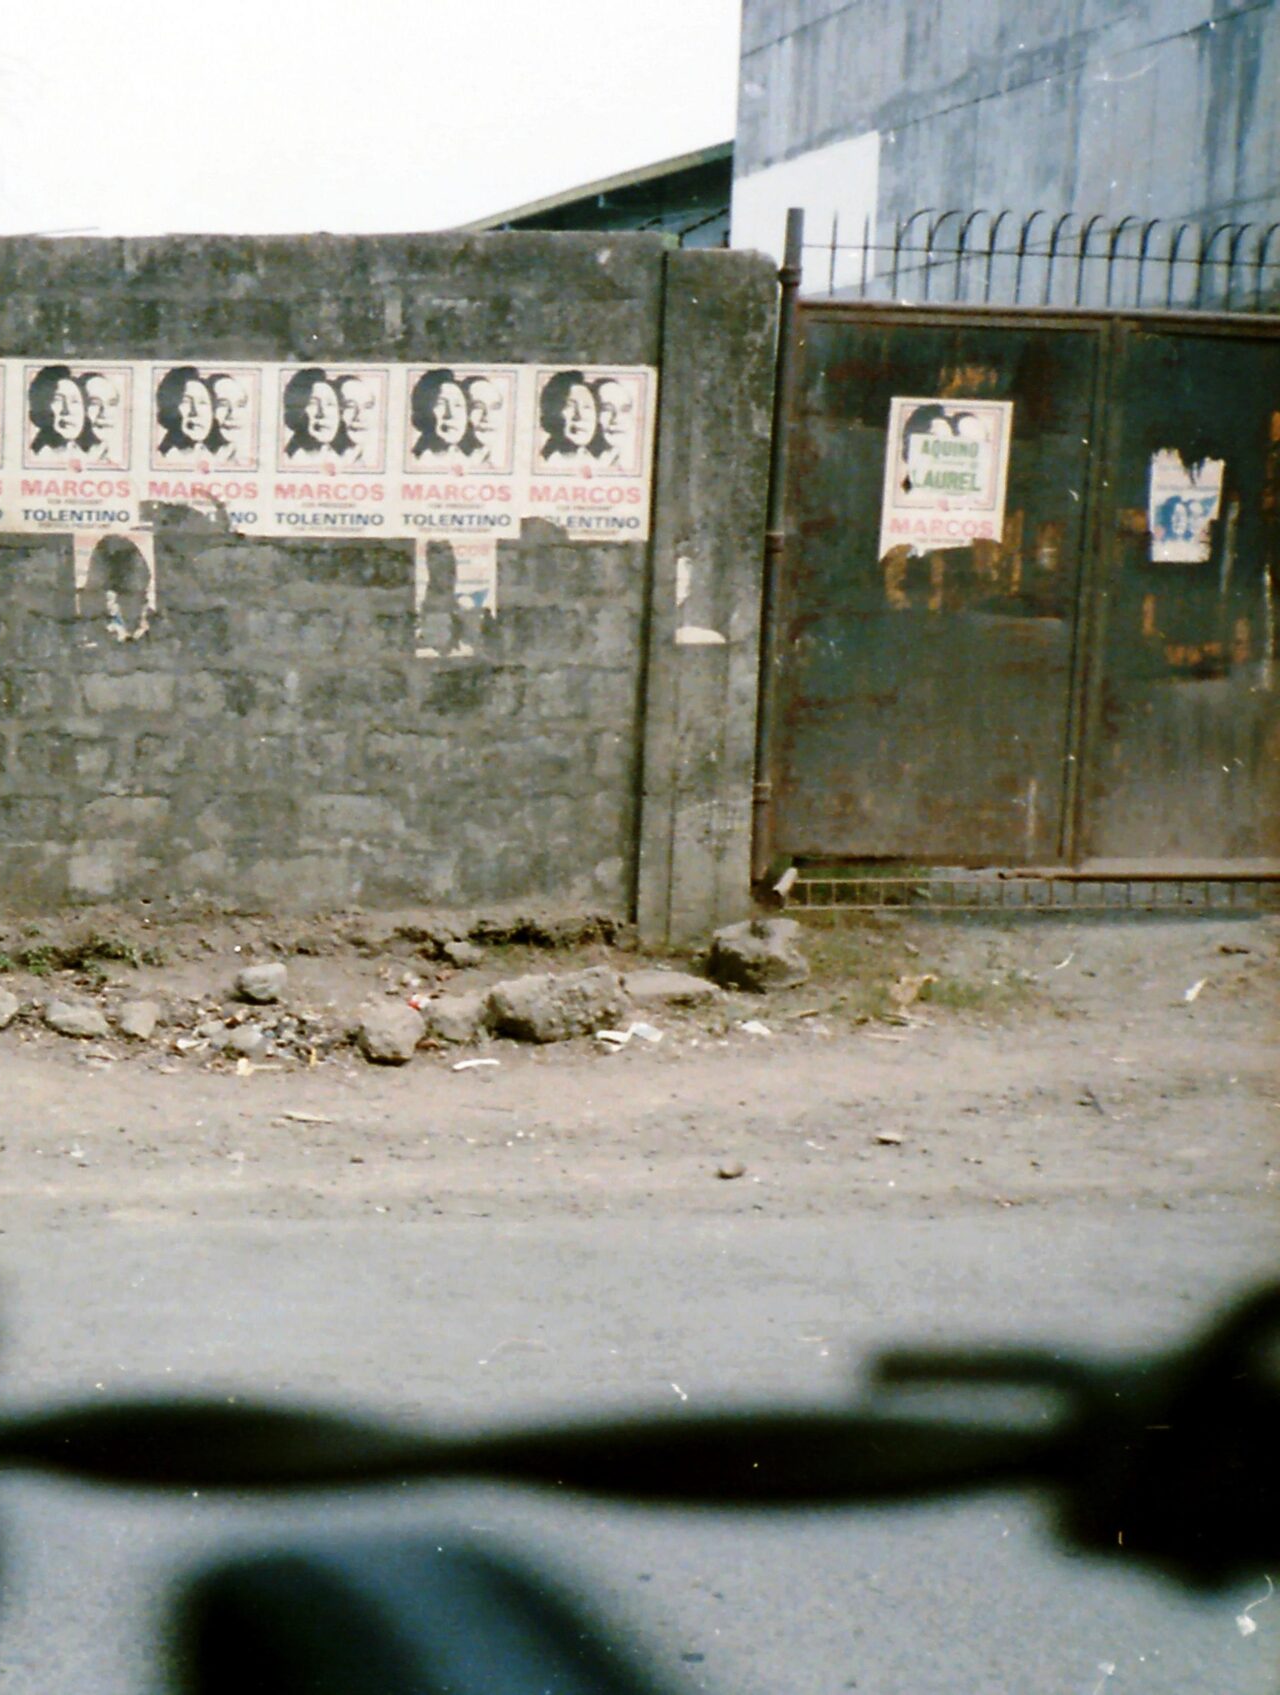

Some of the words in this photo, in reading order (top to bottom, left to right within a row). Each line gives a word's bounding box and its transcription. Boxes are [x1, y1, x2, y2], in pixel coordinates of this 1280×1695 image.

[921, 440, 979, 458] AQUINO
[20, 479, 131, 498] MARCOS
[148, 481, 258, 499] MARCOS
[911, 470, 981, 492] LAUREL
[274, 483, 384, 501] MARCOS
[401, 484, 512, 502] MARCOS
[529, 486, 641, 504] MARCOS
[22, 509, 130, 522] TOLENTINO
[275, 513, 384, 526] TOLENTINO
[402, 513, 511, 527] TOLENTINO
[890, 517, 993, 538] MARCOS
